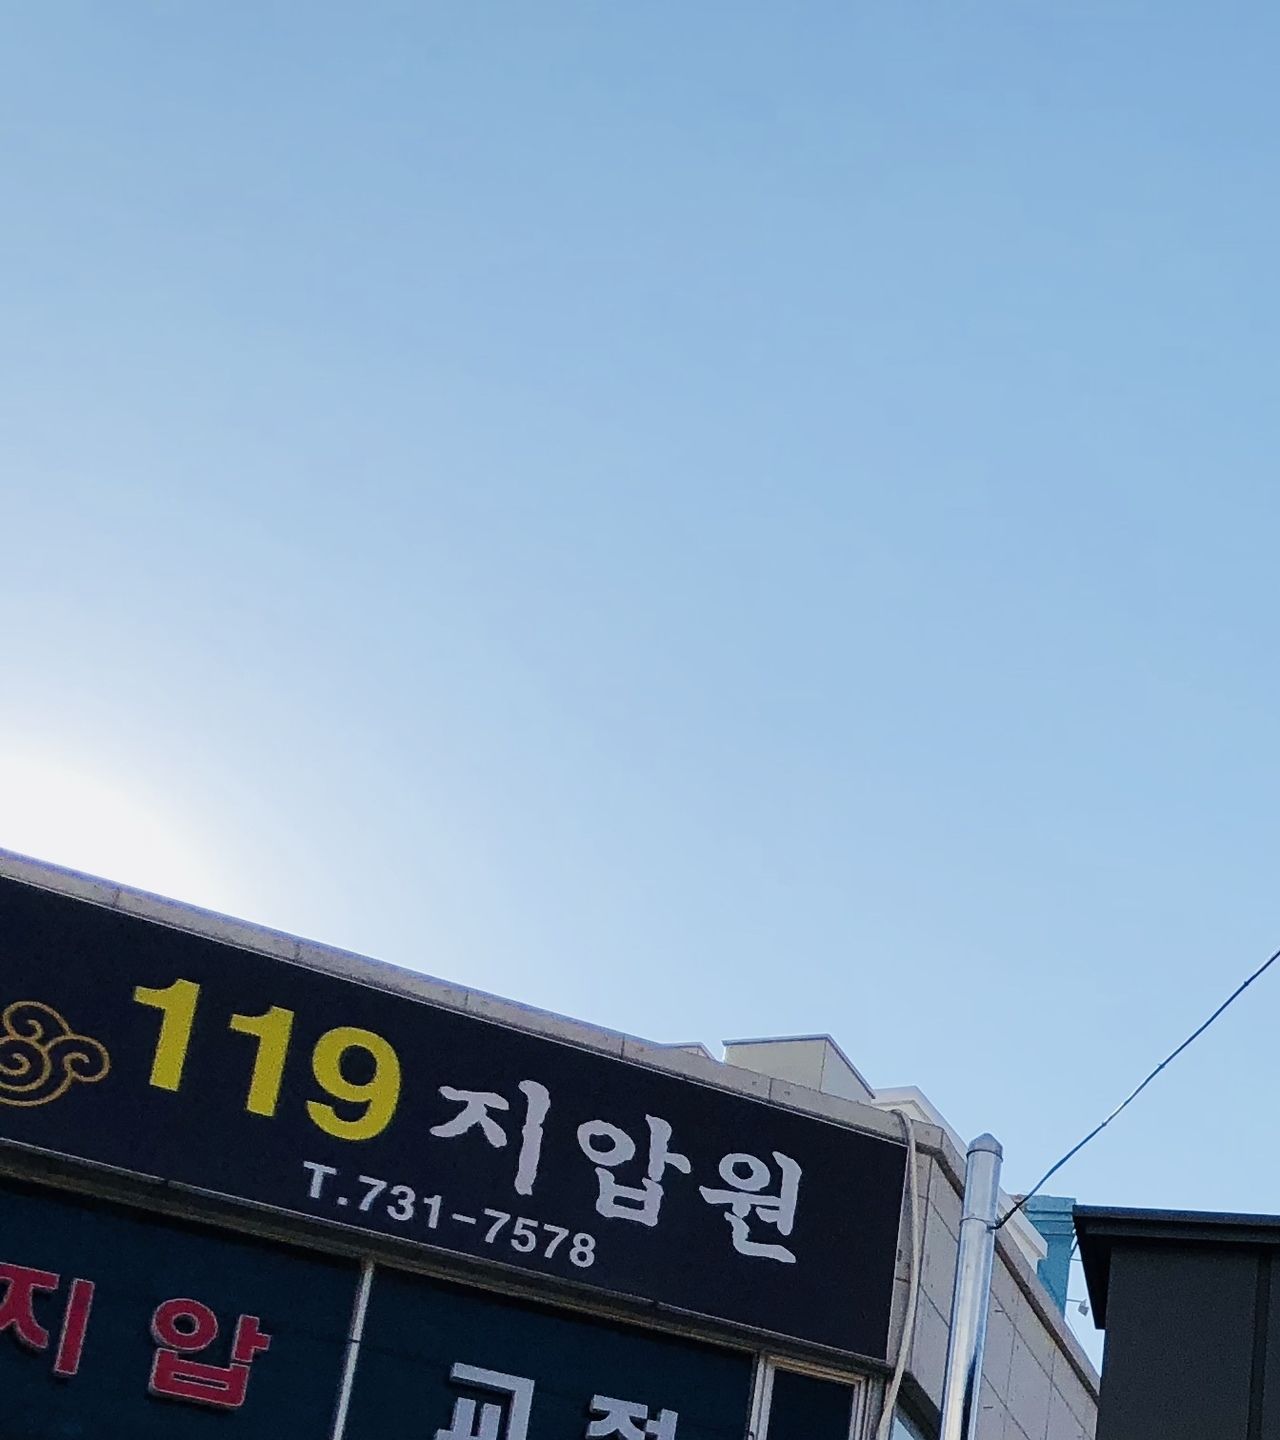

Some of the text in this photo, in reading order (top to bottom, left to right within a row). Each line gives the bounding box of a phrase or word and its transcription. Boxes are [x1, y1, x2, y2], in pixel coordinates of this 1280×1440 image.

[133, 978, 803, 1264] 119 지압원
[302, 1160, 598, 1269] T.731-7578
[0, 1262, 272, 1409] 지압
